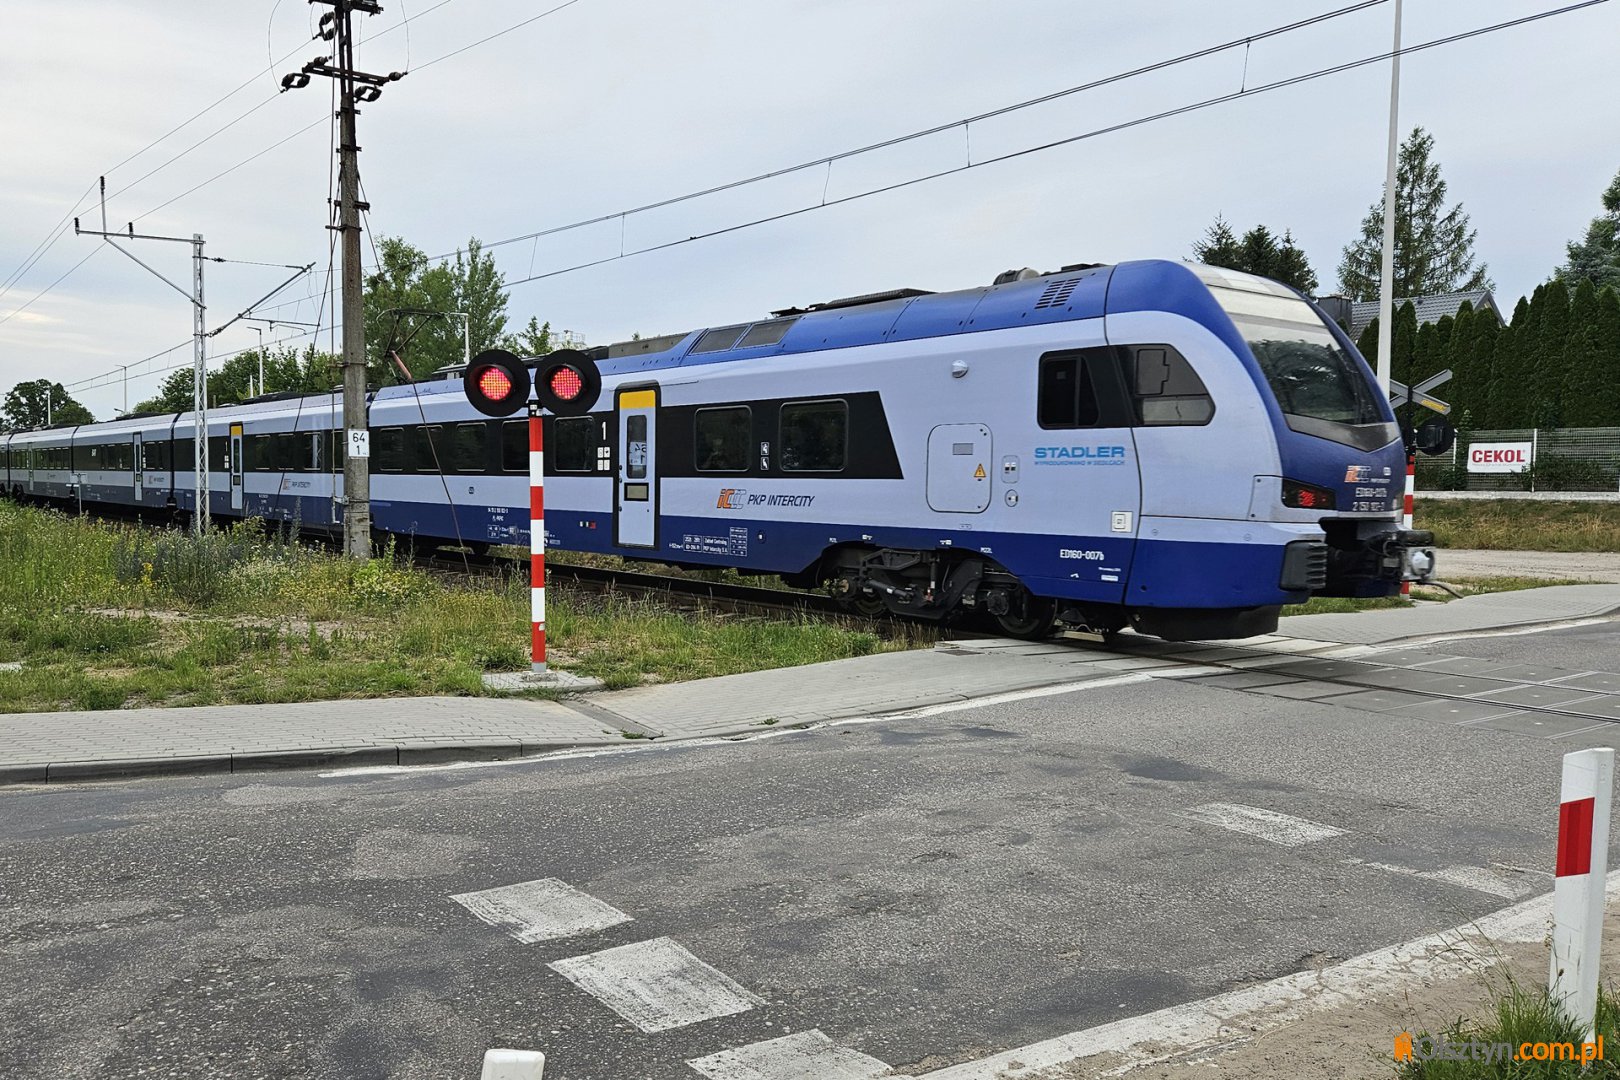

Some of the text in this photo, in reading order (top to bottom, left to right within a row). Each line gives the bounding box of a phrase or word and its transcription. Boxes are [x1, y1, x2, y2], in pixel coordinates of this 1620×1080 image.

[601, 421, 607, 440] 1
[352, 432, 365, 443] 64
[356, 445, 360, 455] 1
[1034, 446, 1125, 458] STADLER
[1472, 449, 1525, 463] CEKOL
[747, 494, 815, 507] PKP INTERCITY
